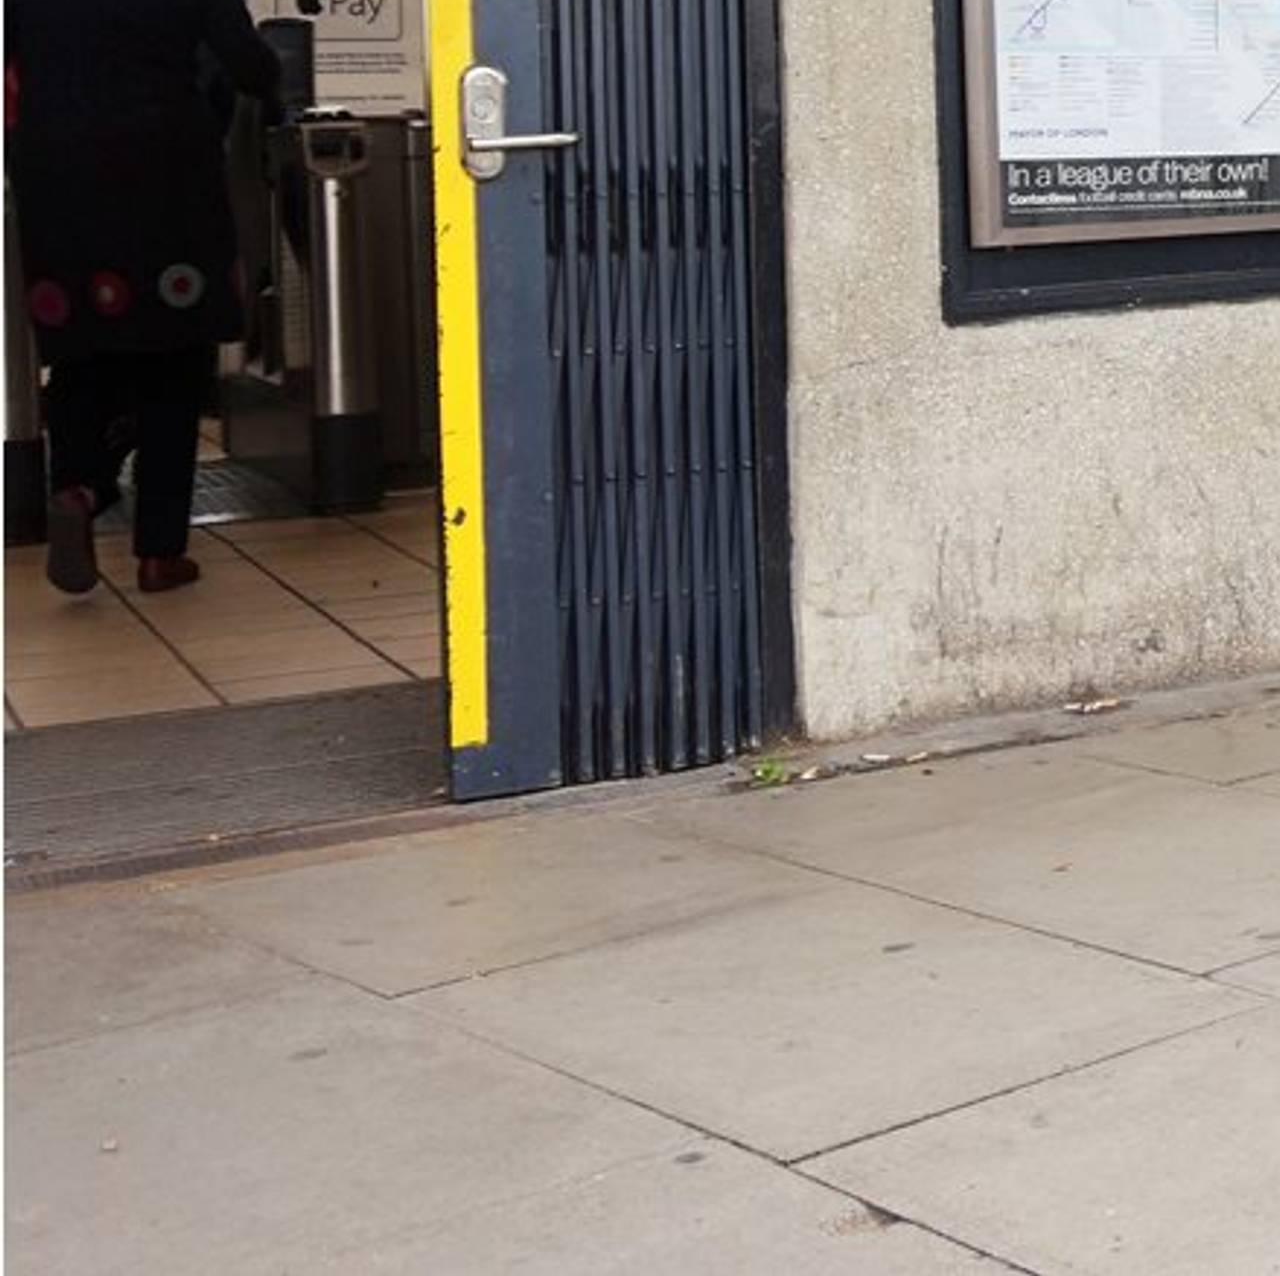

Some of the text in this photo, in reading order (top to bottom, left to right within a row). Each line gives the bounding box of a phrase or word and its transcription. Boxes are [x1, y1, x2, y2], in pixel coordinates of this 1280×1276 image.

[1008, 157, 1269, 191] In a league of their own!
[1008, 191, 1077, 206] Contactless
